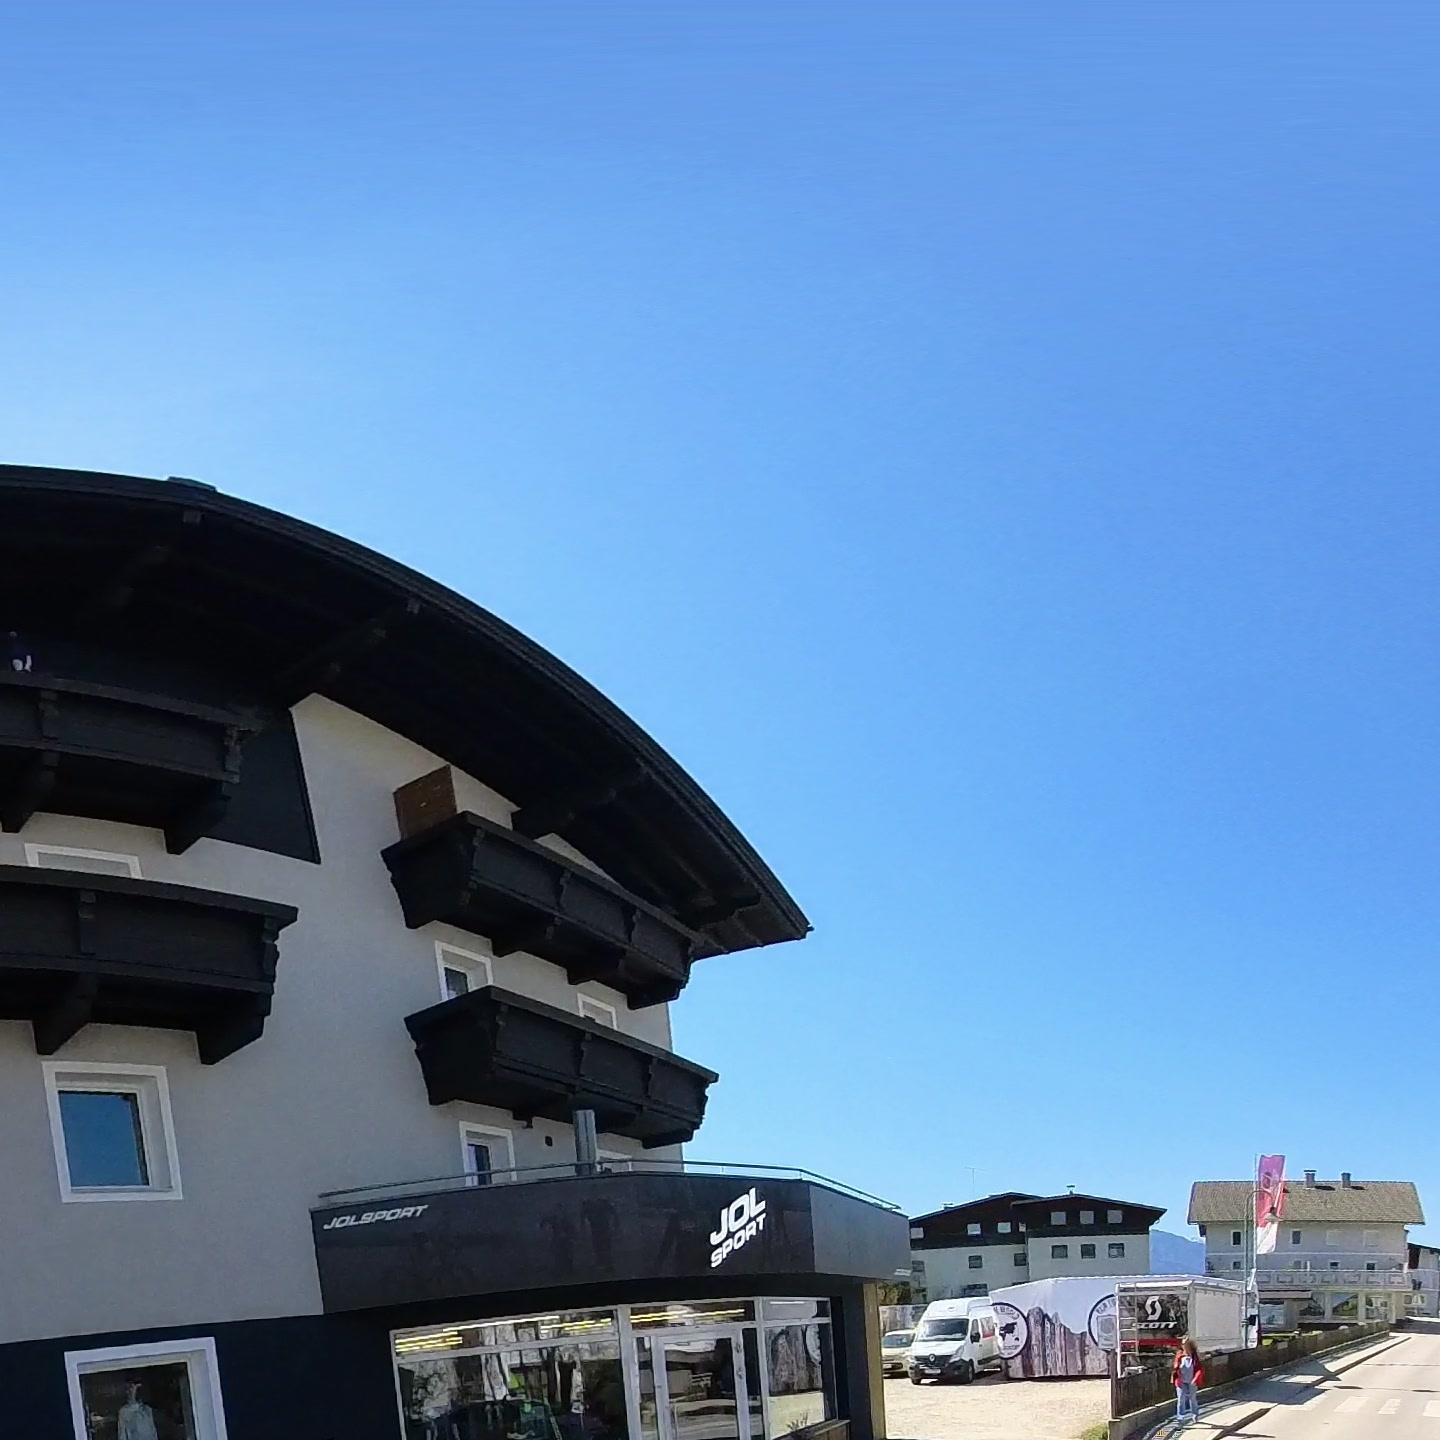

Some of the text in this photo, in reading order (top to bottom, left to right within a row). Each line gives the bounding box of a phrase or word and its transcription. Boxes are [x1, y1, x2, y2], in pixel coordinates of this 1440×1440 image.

[323, 1204, 429, 1230] JOLSPORT
[710, 1187, 766, 1246] JOL
[711, 1212, 767, 1268] SPORT
[1132, 1321, 1177, 1329] SCOTT
